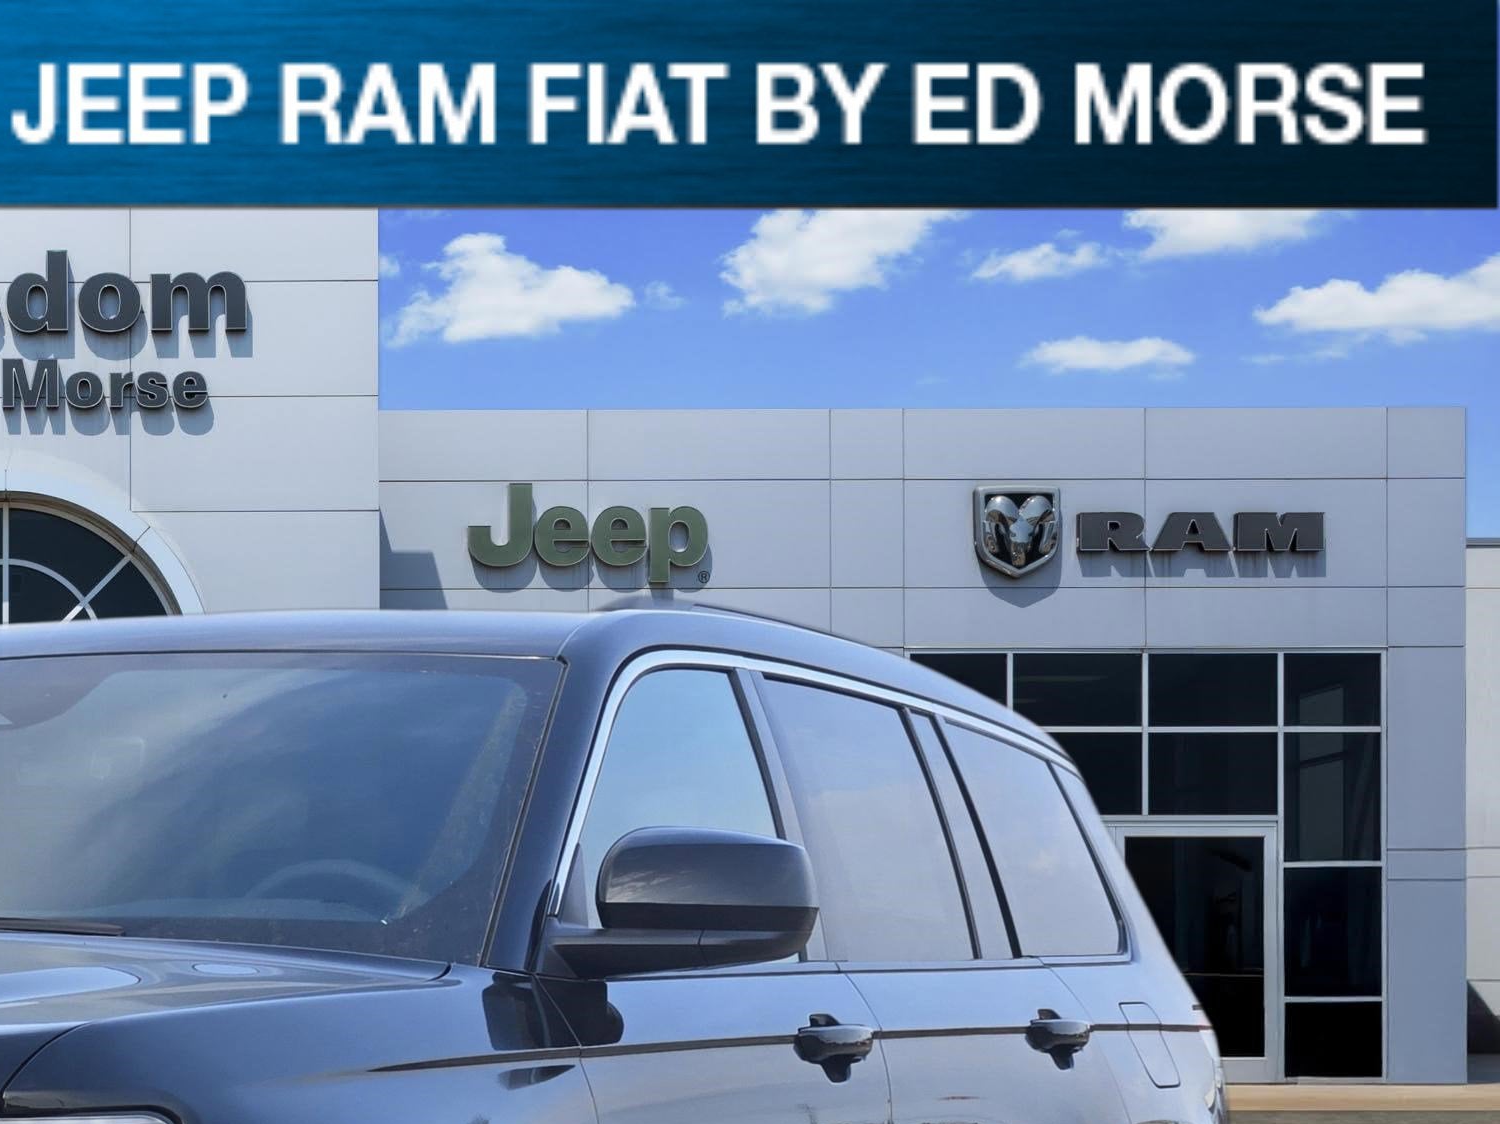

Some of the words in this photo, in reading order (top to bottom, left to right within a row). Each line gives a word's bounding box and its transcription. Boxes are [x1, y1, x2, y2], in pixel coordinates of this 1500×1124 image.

[1, 358, 210, 412] Morse
[467, 482, 709, 584] Jeep
[1076, 511, 1327, 553] RAM
